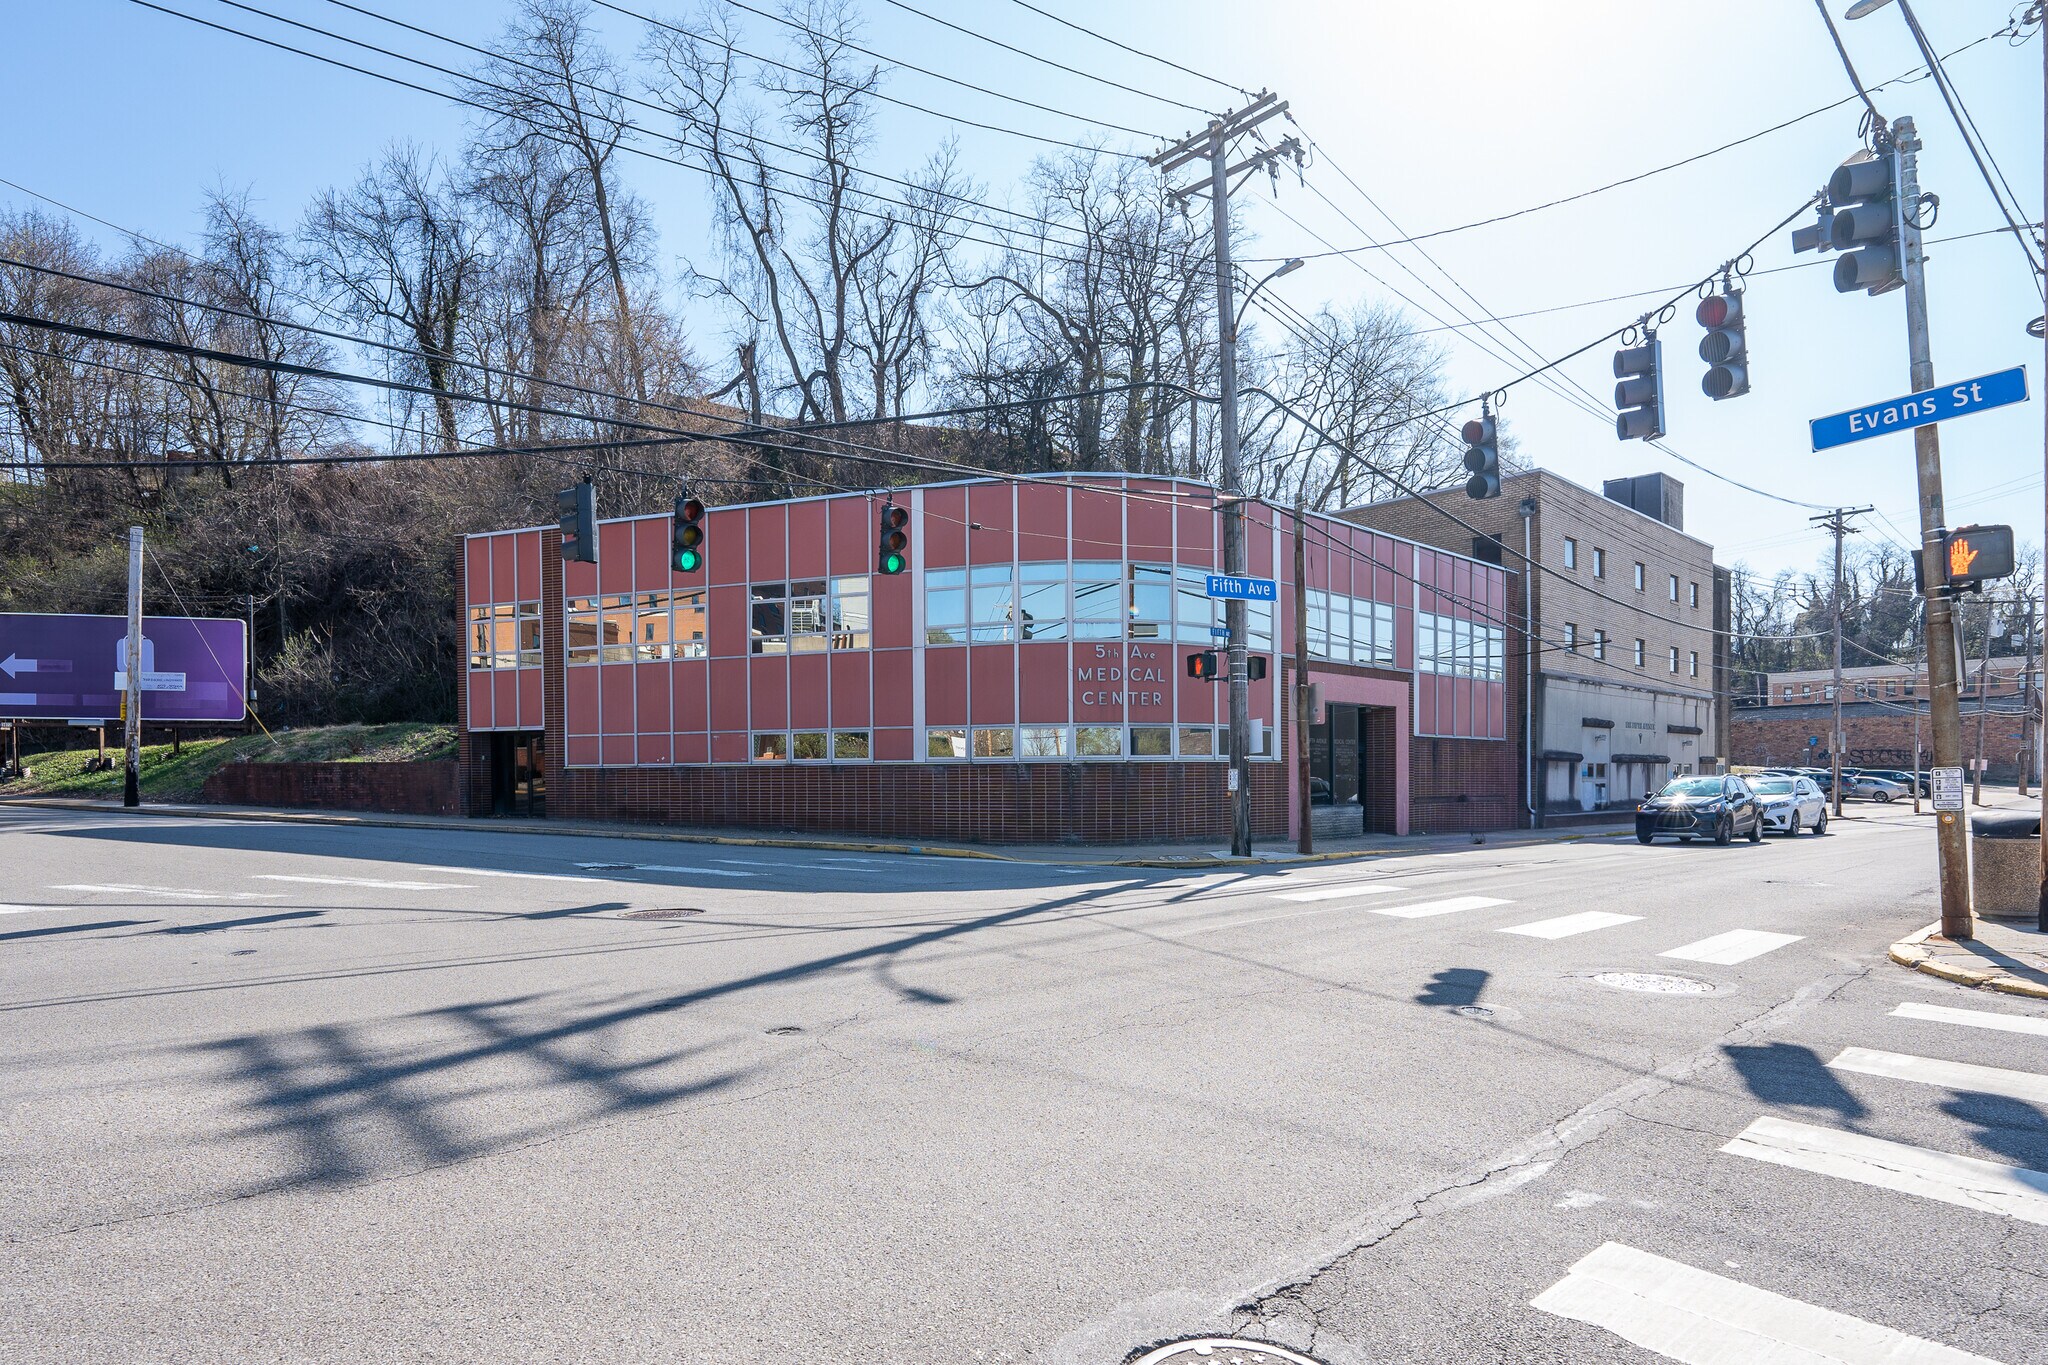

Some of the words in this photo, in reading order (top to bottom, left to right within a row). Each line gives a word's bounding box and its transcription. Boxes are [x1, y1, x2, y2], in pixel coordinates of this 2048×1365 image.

[1848, 397, 1937, 433] Evans
[1953, 382, 1983, 408] St
[1212, 578, 1242, 594] Fifth
[1248, 582, 1271, 596] Ave
[1095, 644, 1119, 658] 5th
[1130, 644, 1156, 659] Ave
[1078, 667, 1166, 682] MEDICAL
[1081, 691, 1162, 706] CENTER
